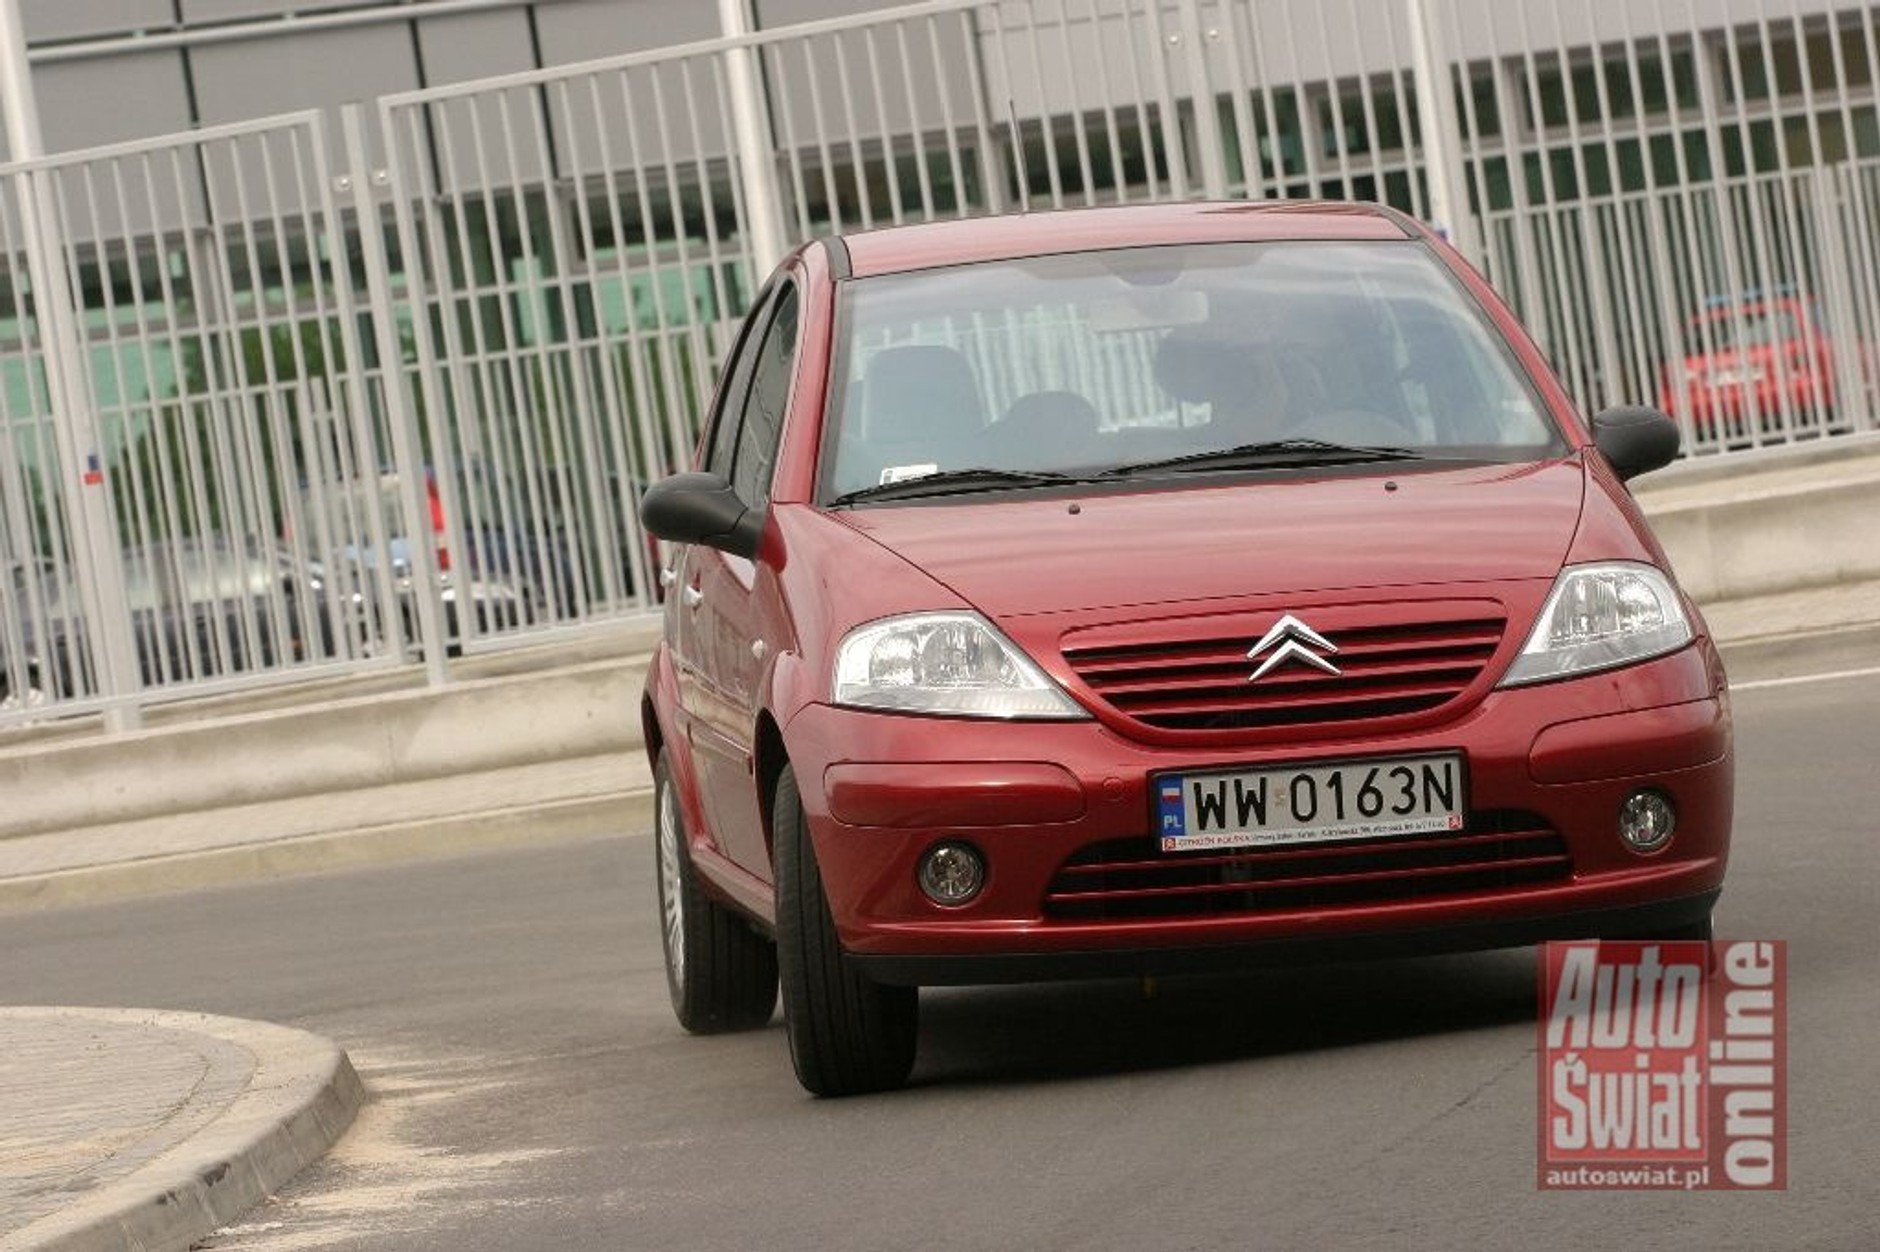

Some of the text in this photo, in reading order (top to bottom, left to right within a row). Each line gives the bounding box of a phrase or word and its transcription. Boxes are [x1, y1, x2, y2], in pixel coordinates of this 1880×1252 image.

[1193, 762, 1454, 831] WW 0163N
[1164, 815, 1182, 829] PL
